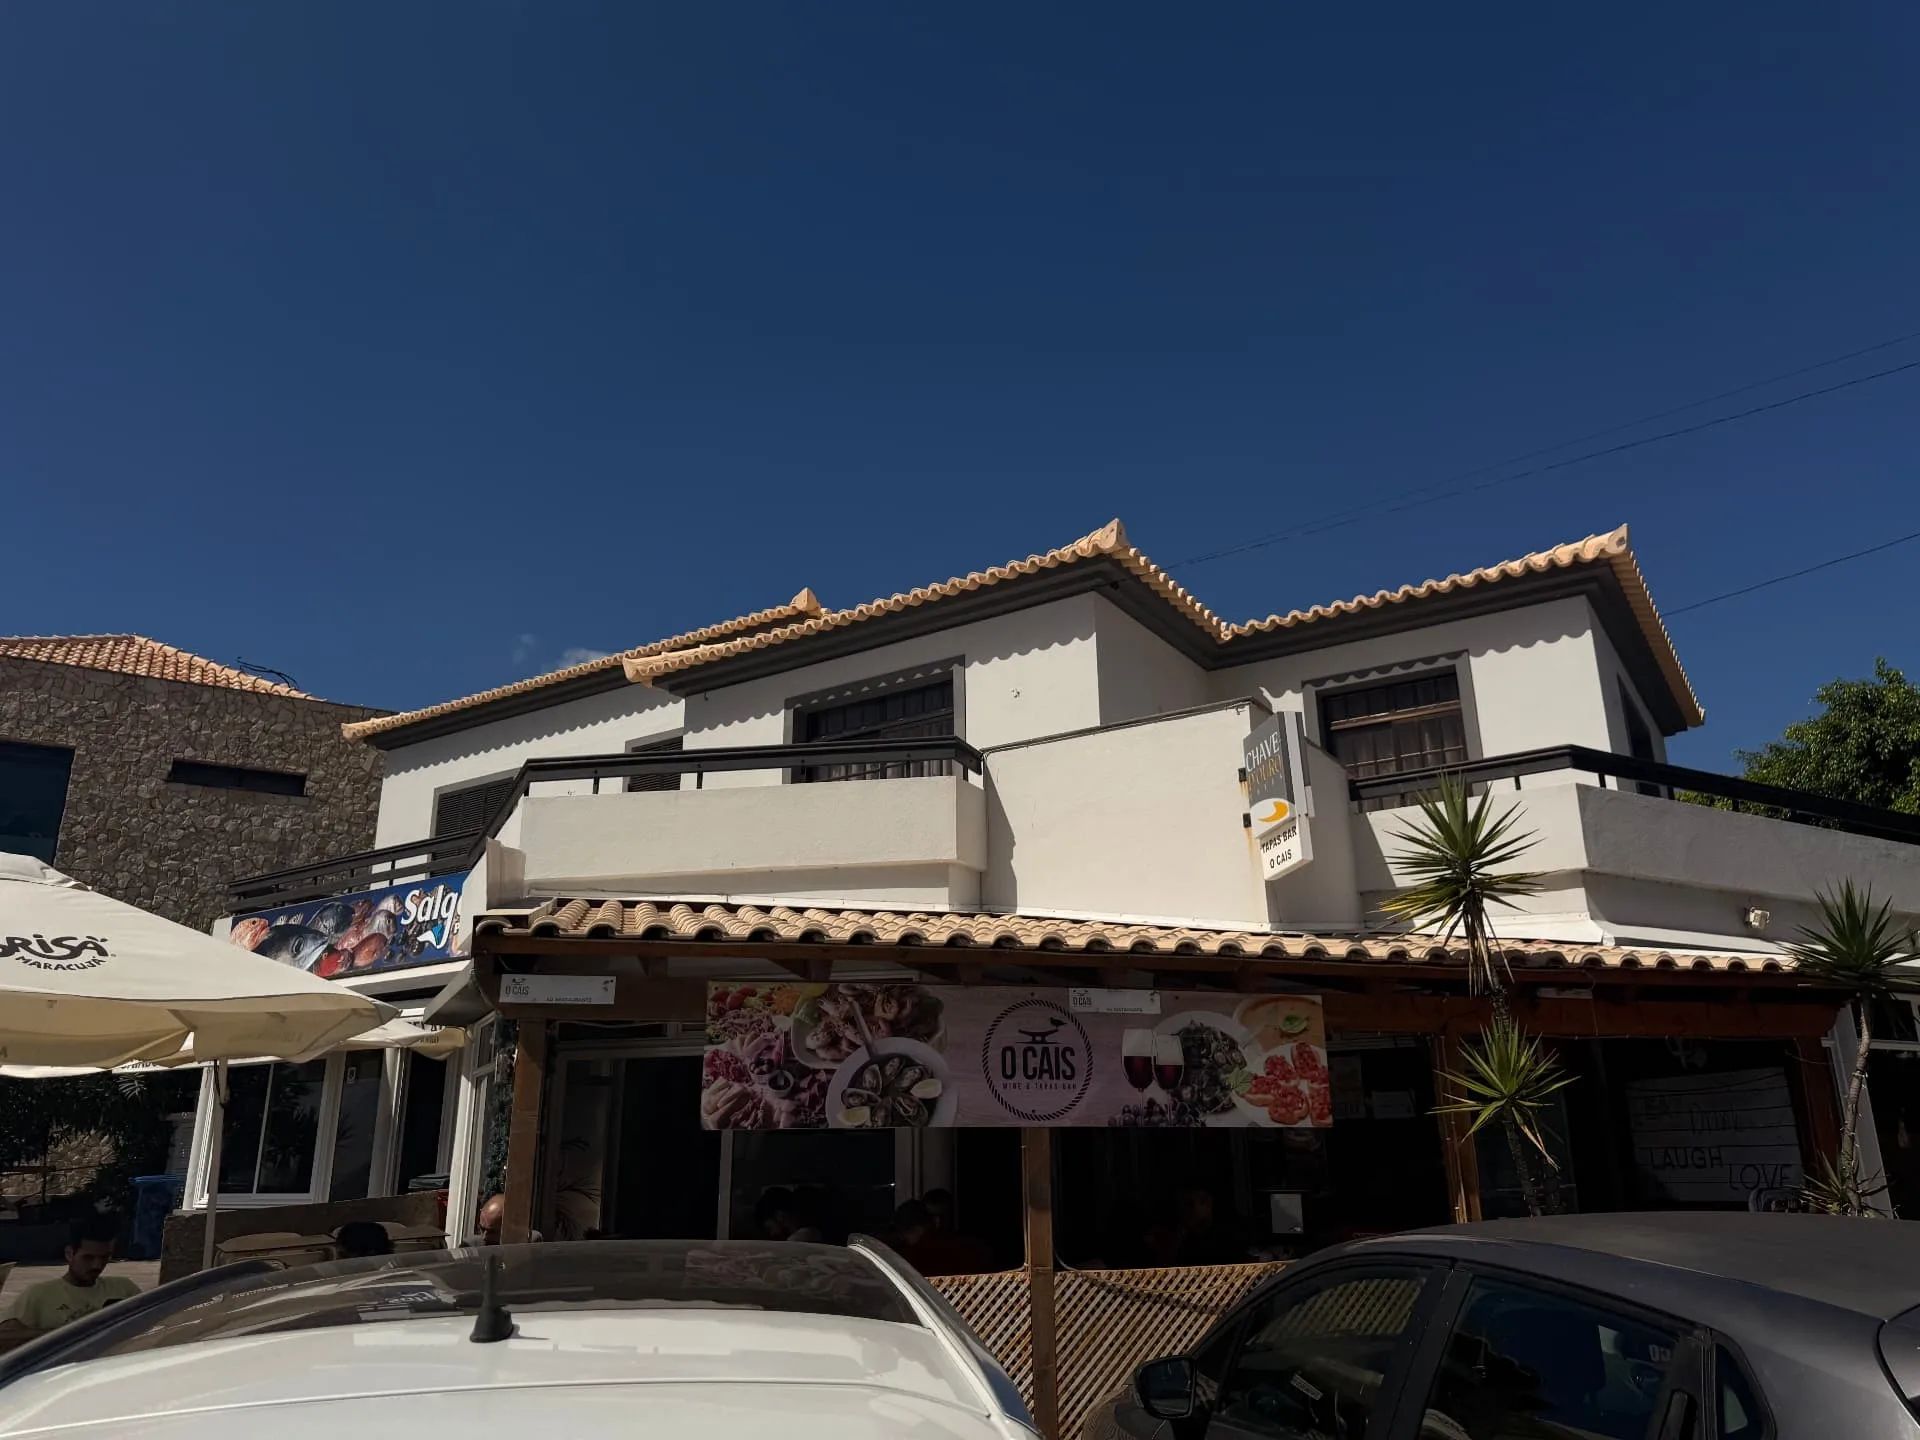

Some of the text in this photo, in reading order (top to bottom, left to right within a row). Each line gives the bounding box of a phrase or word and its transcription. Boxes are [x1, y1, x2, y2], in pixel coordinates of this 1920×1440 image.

[1245, 731, 1280, 773] CHAVE
[1261, 826, 1297, 853] TAPAS BAR
[1269, 848, 1292, 869] O CAIS
[401, 884, 461, 950] Salg
[1001, 1046, 1076, 1080] O CAIS
[1649, 1147, 1724, 1169] LAUGH
[1728, 1164, 1792, 1190] LOVE
